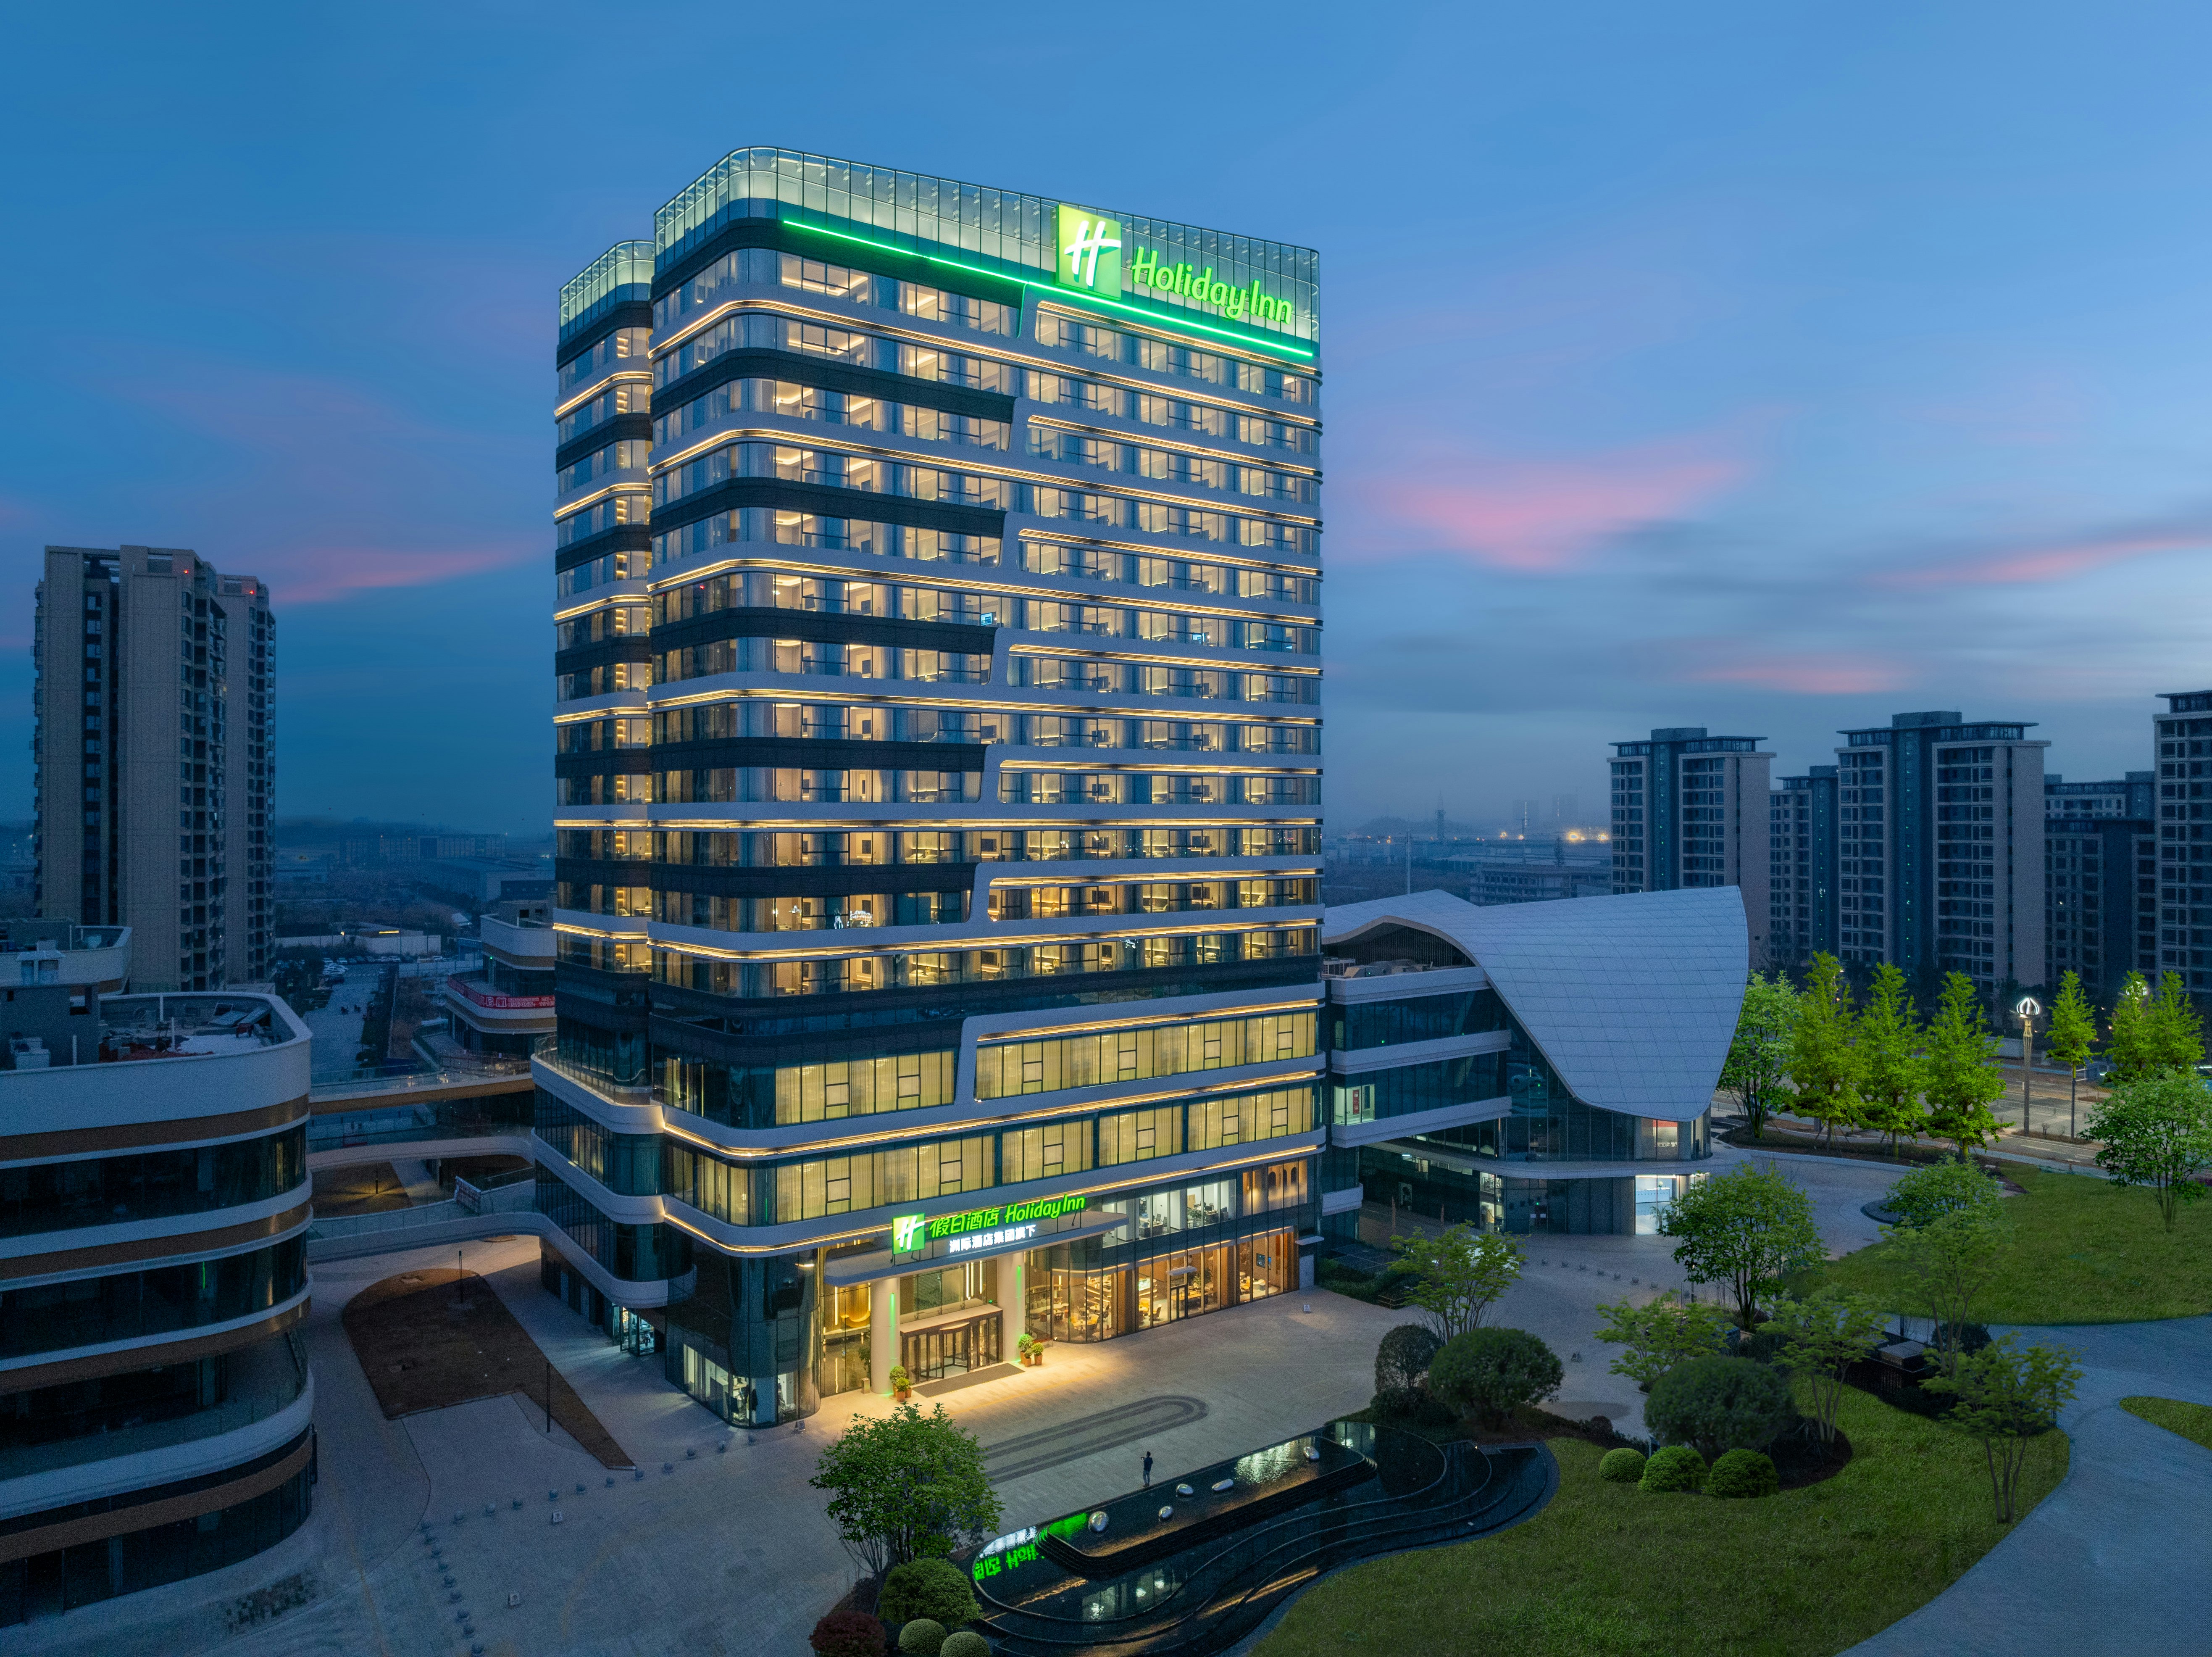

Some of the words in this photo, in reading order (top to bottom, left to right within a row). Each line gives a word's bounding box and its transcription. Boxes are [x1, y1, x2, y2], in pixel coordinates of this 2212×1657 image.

[1131, 245, 1246, 320] Holiday
[1249, 279, 1293, 324] Inn
[929, 1209, 1000, 1238] 假日酒店
[1005, 1199, 1062, 1224] Holiday
[1063, 1194, 1085, 1212] Inn
